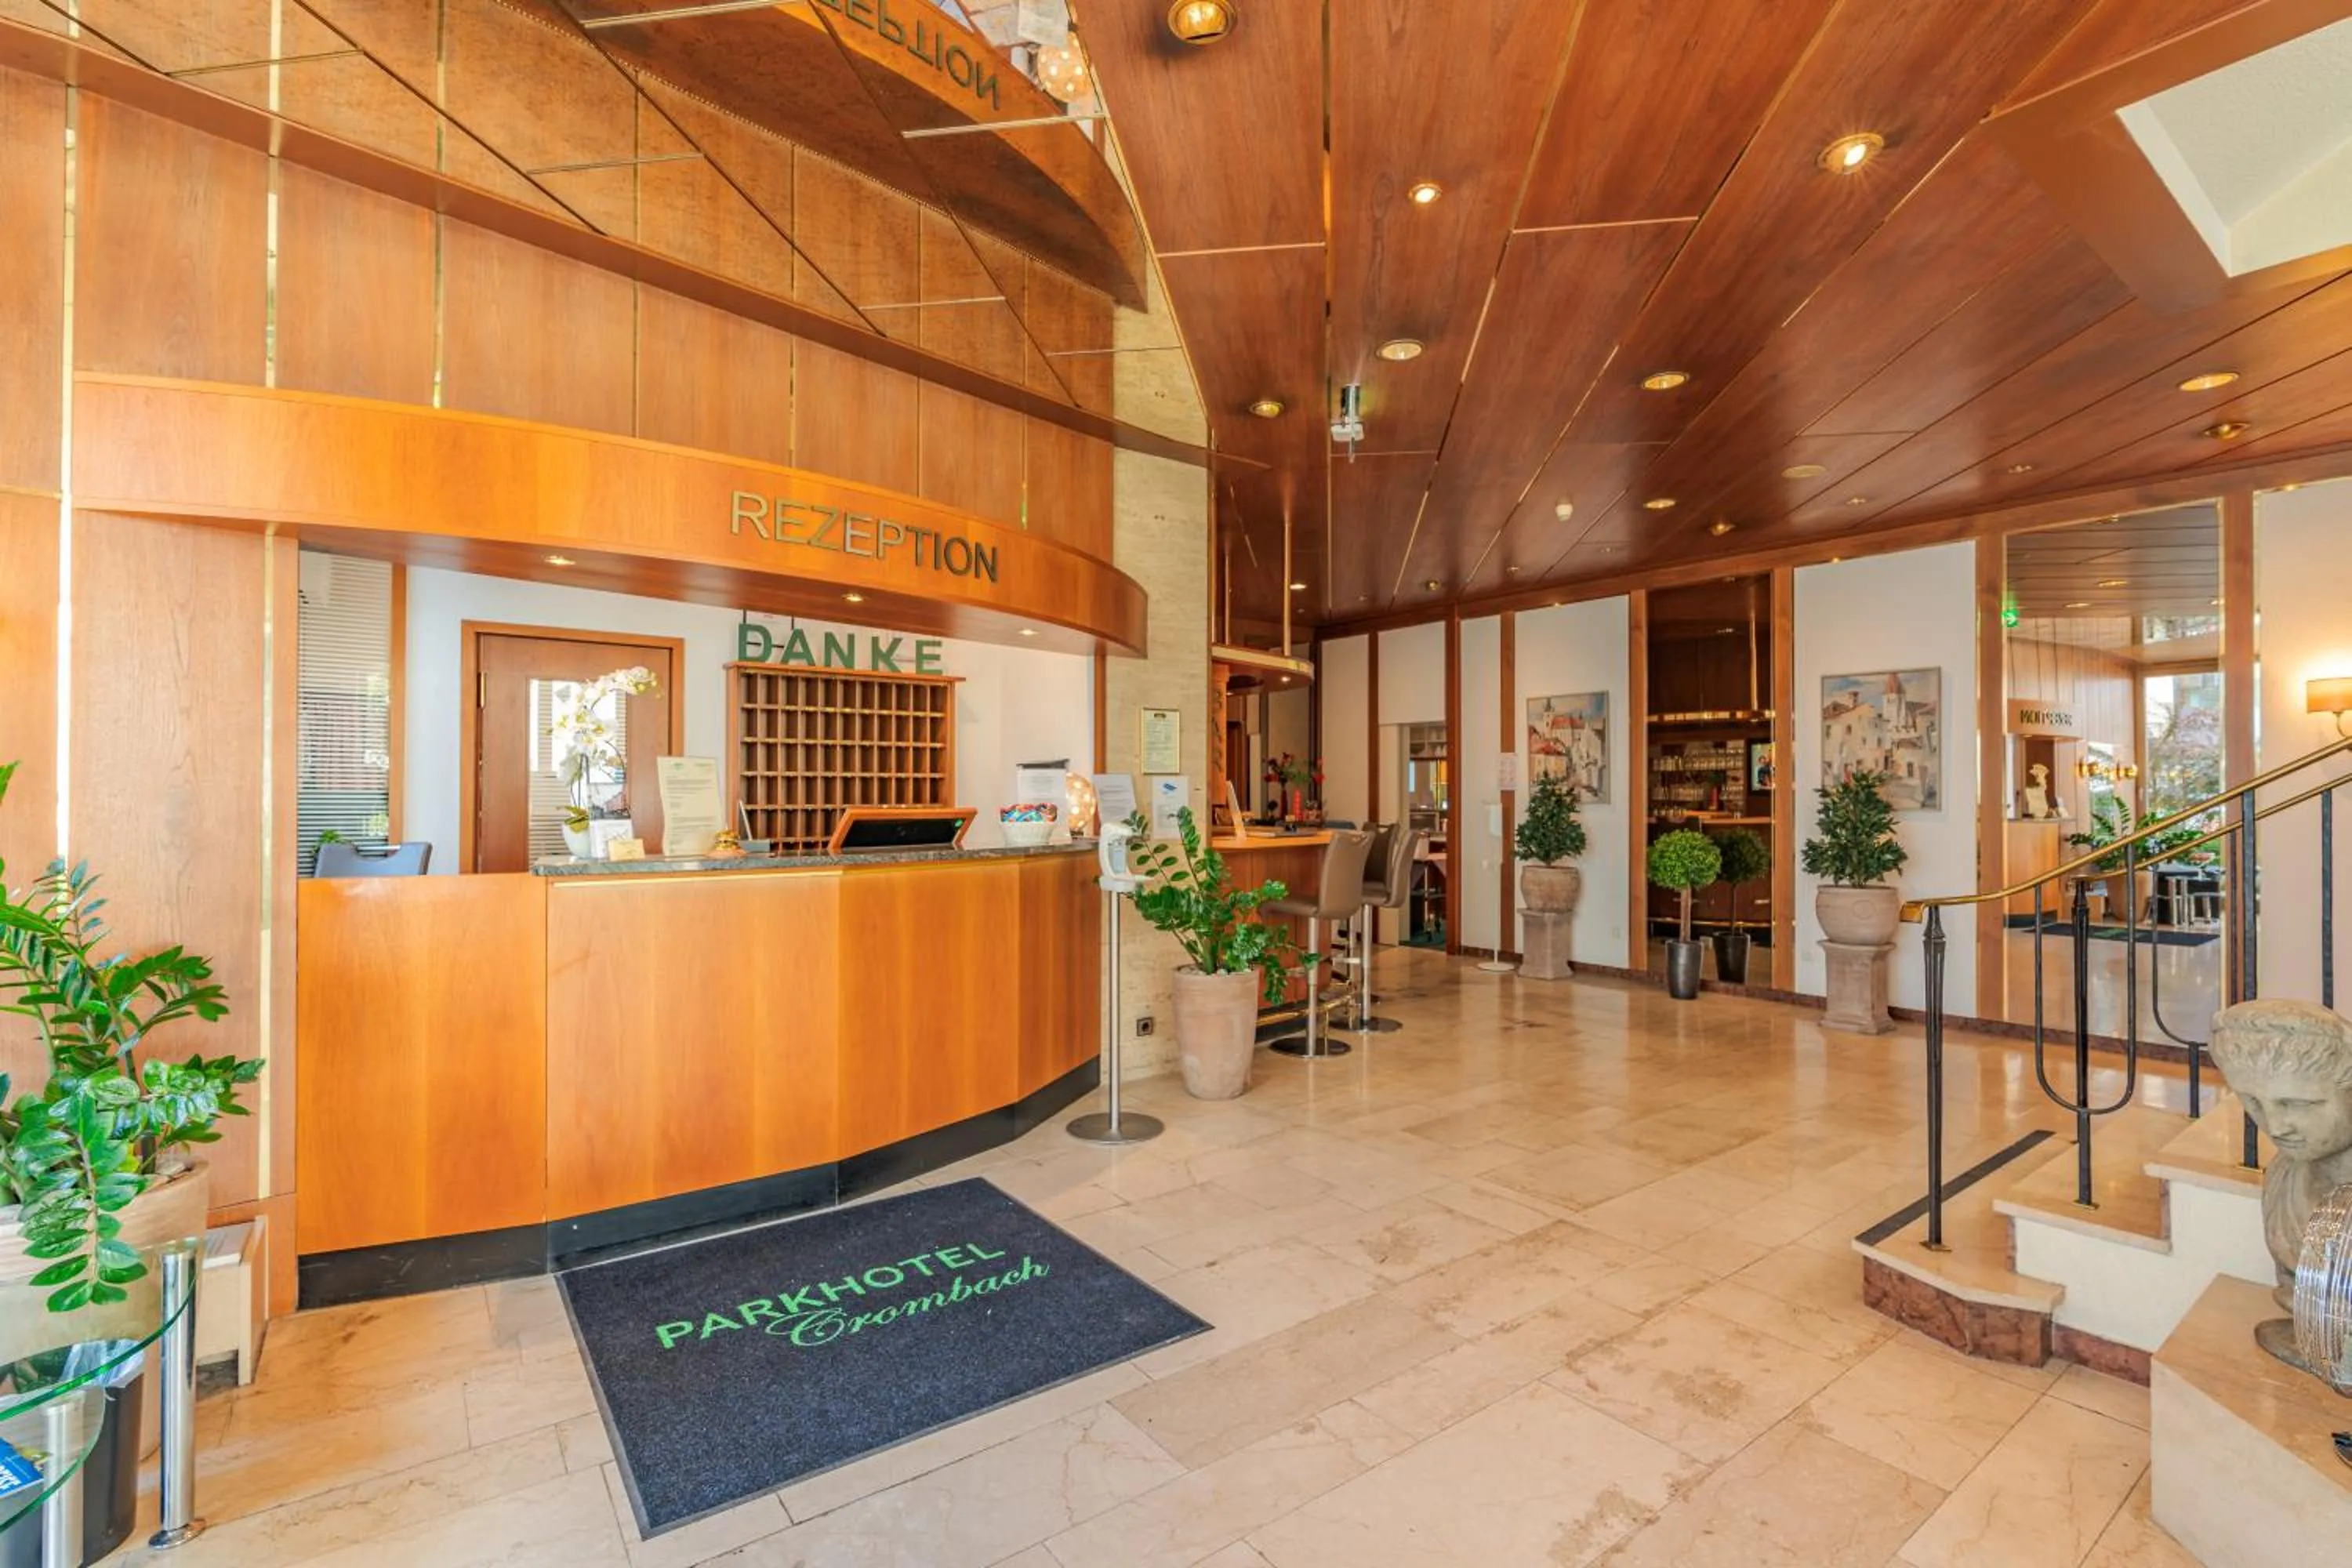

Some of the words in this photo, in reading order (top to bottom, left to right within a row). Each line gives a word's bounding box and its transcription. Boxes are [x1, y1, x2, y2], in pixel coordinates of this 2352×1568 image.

[730, 490, 999, 583] REZEPTION
[738, 623, 943, 675] DANKE
[655, 1243, 1005, 1349] PARKHOTEL
[765, 1255, 1050, 1346] Crombach
